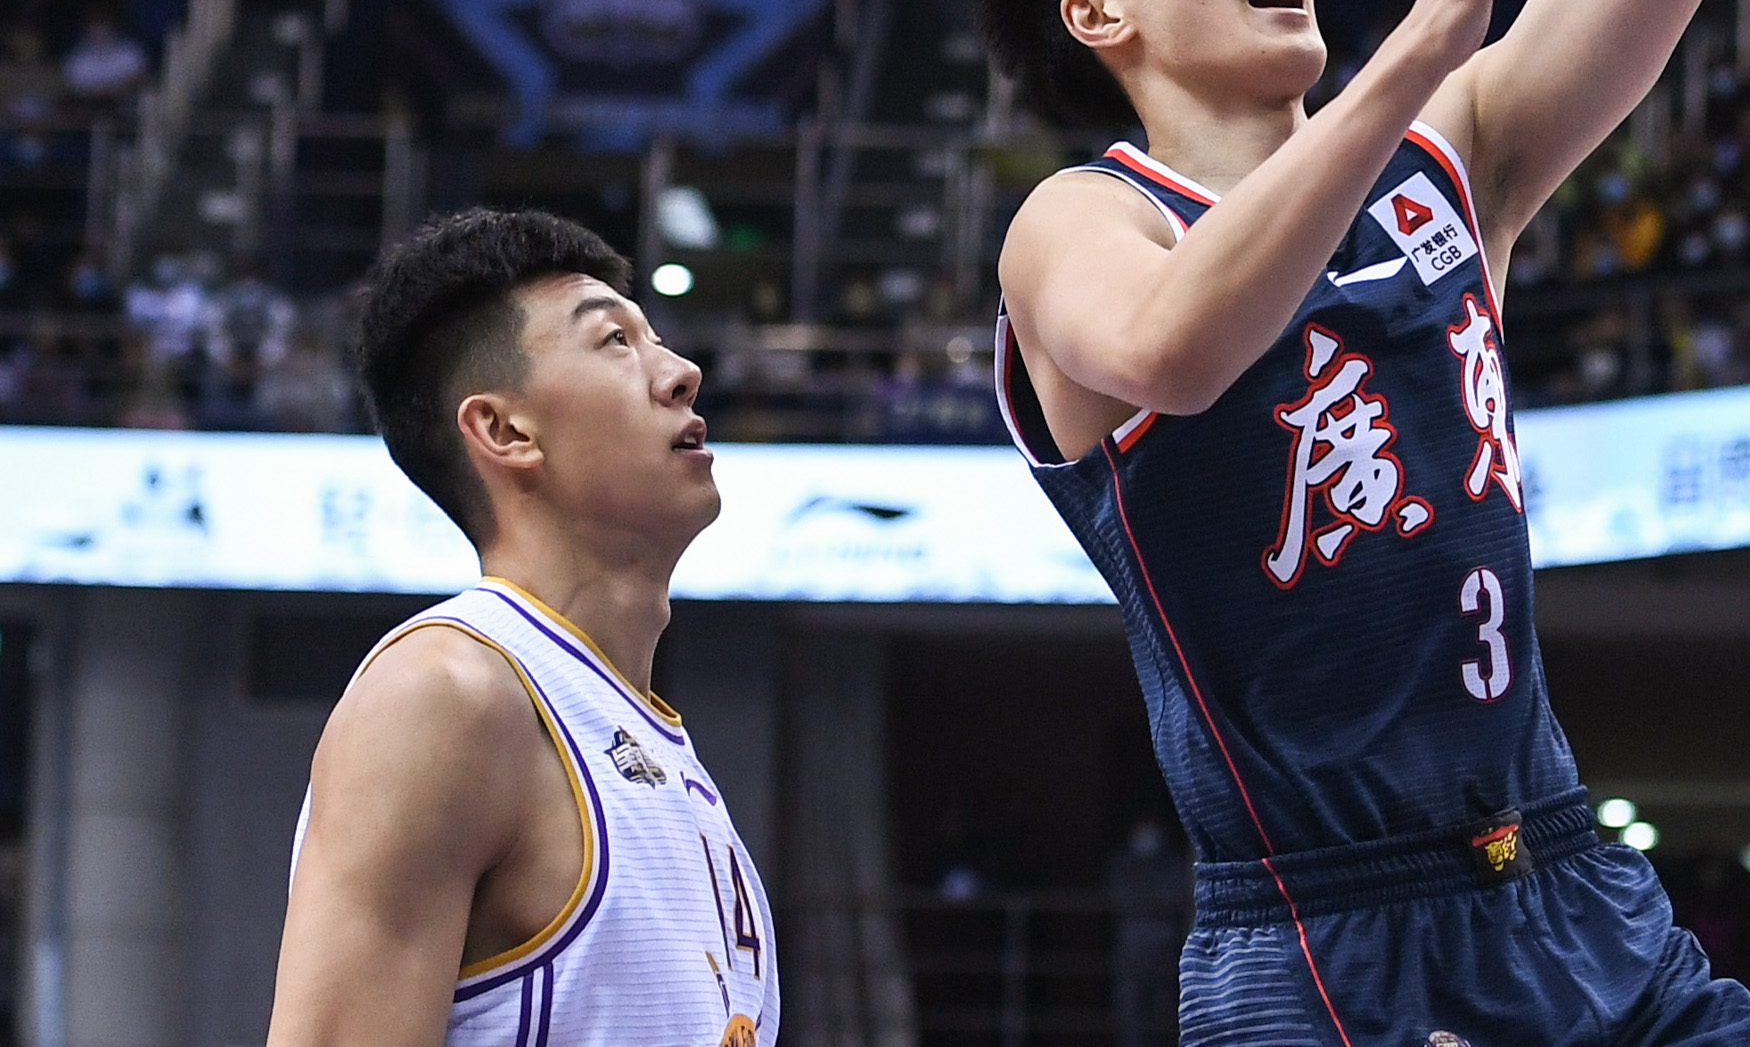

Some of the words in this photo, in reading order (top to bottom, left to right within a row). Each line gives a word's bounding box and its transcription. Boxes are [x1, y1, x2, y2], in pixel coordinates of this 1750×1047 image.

[1411, 223, 1458, 262] 广发银行
[1431, 245, 1462, 271] CGB
[1459, 566, 1514, 702] 3
[700, 832, 760, 980] 14
